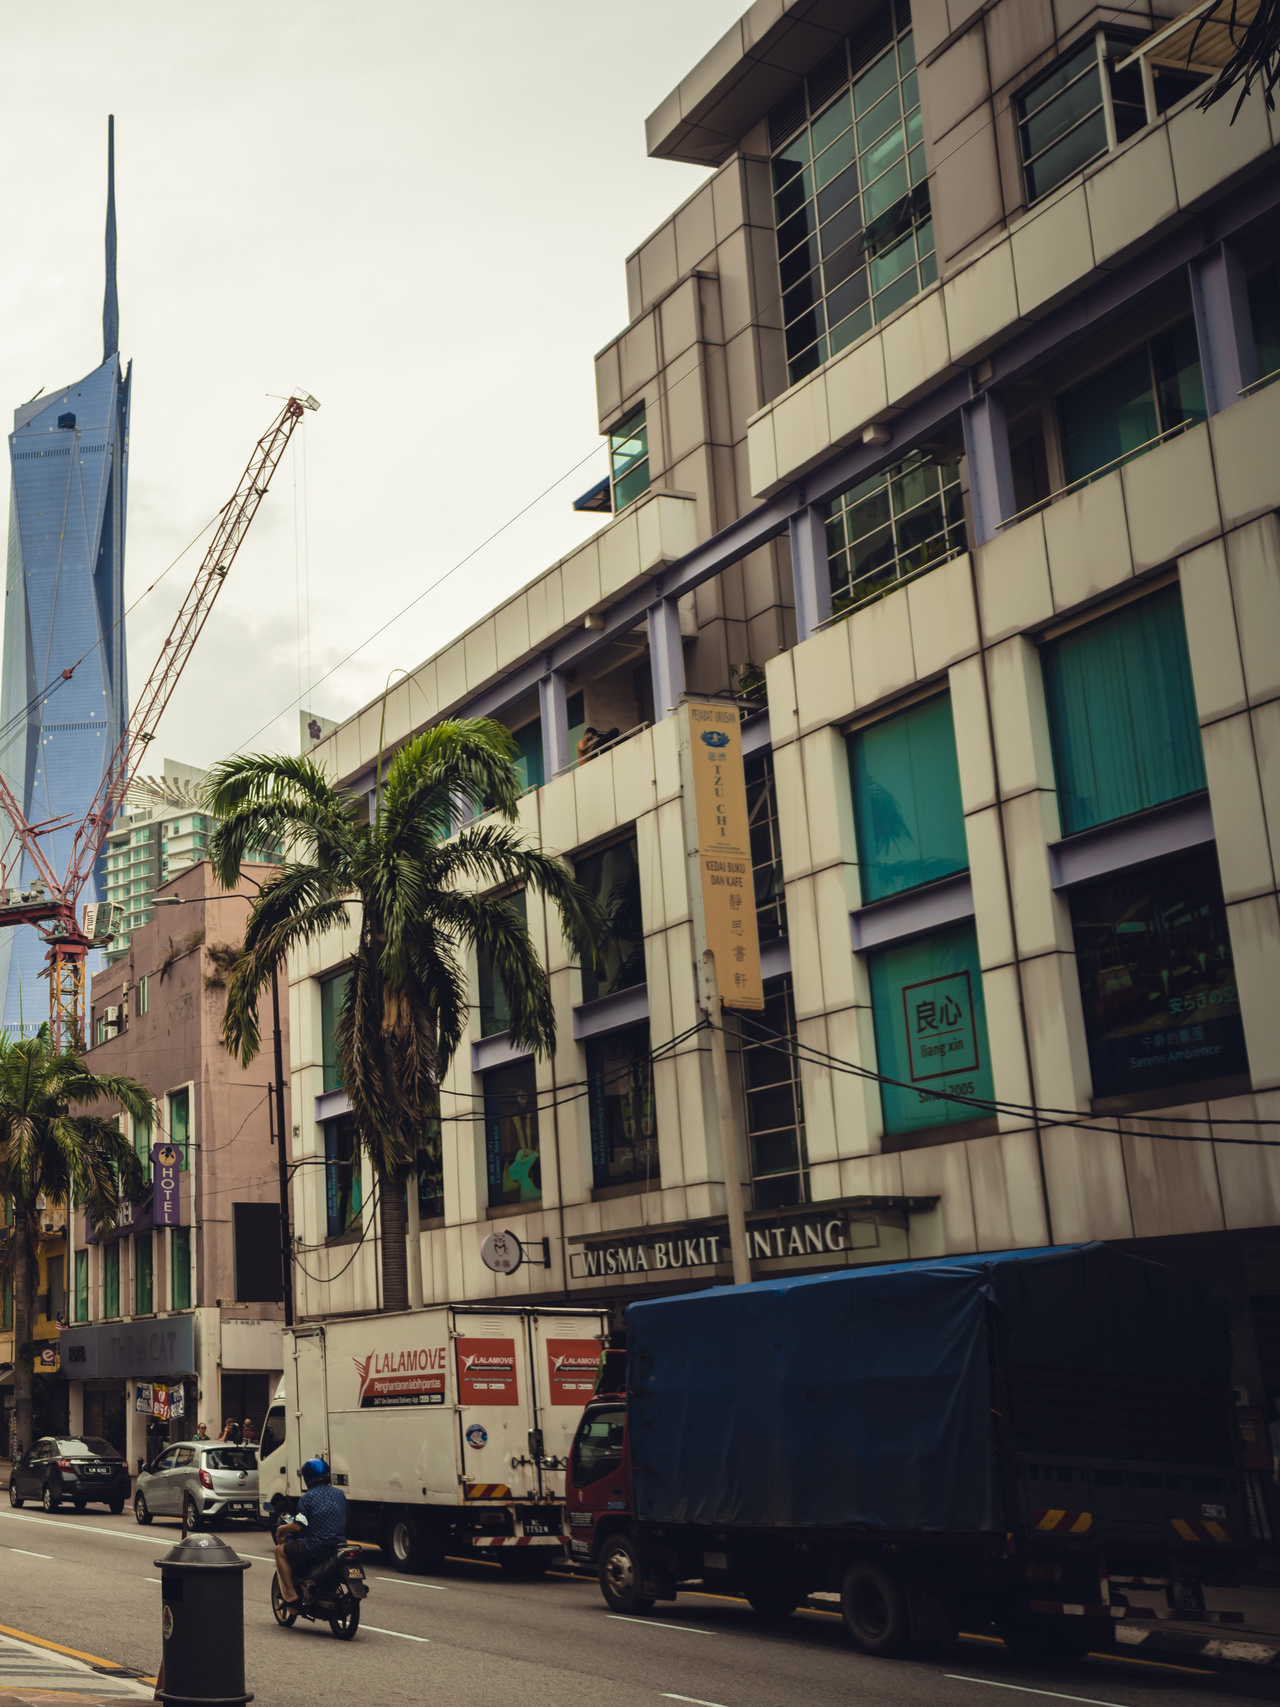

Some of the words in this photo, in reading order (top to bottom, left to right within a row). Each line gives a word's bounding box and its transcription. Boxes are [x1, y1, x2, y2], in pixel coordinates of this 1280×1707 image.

[713, 765, 724, 797] TZU
[716, 804, 727, 836] CHI
[706, 861, 726, 872] KEDAI
[727, 863, 746, 874] BUKU
[711, 875, 725, 886] DAN
[727, 876, 743, 887] KAFE
[916, 995, 963, 1034] 良心
[921, 1043, 946, 1058] liang
[948, 1038, 964, 1053] xin
[1130, 1053, 1166, 1069] Serene
[1168, 1043, 1221, 1062] Ambience
[161, 1167, 175, 1224] HOTEL
[580, 1244, 649, 1276] WISMA
[655, 1236, 720, 1269] BUKIT
[745, 1220, 845, 1259] INTANG
[149, 1332, 176, 1361] CAT
[375, 1347, 446, 1374] LALAMOVE
